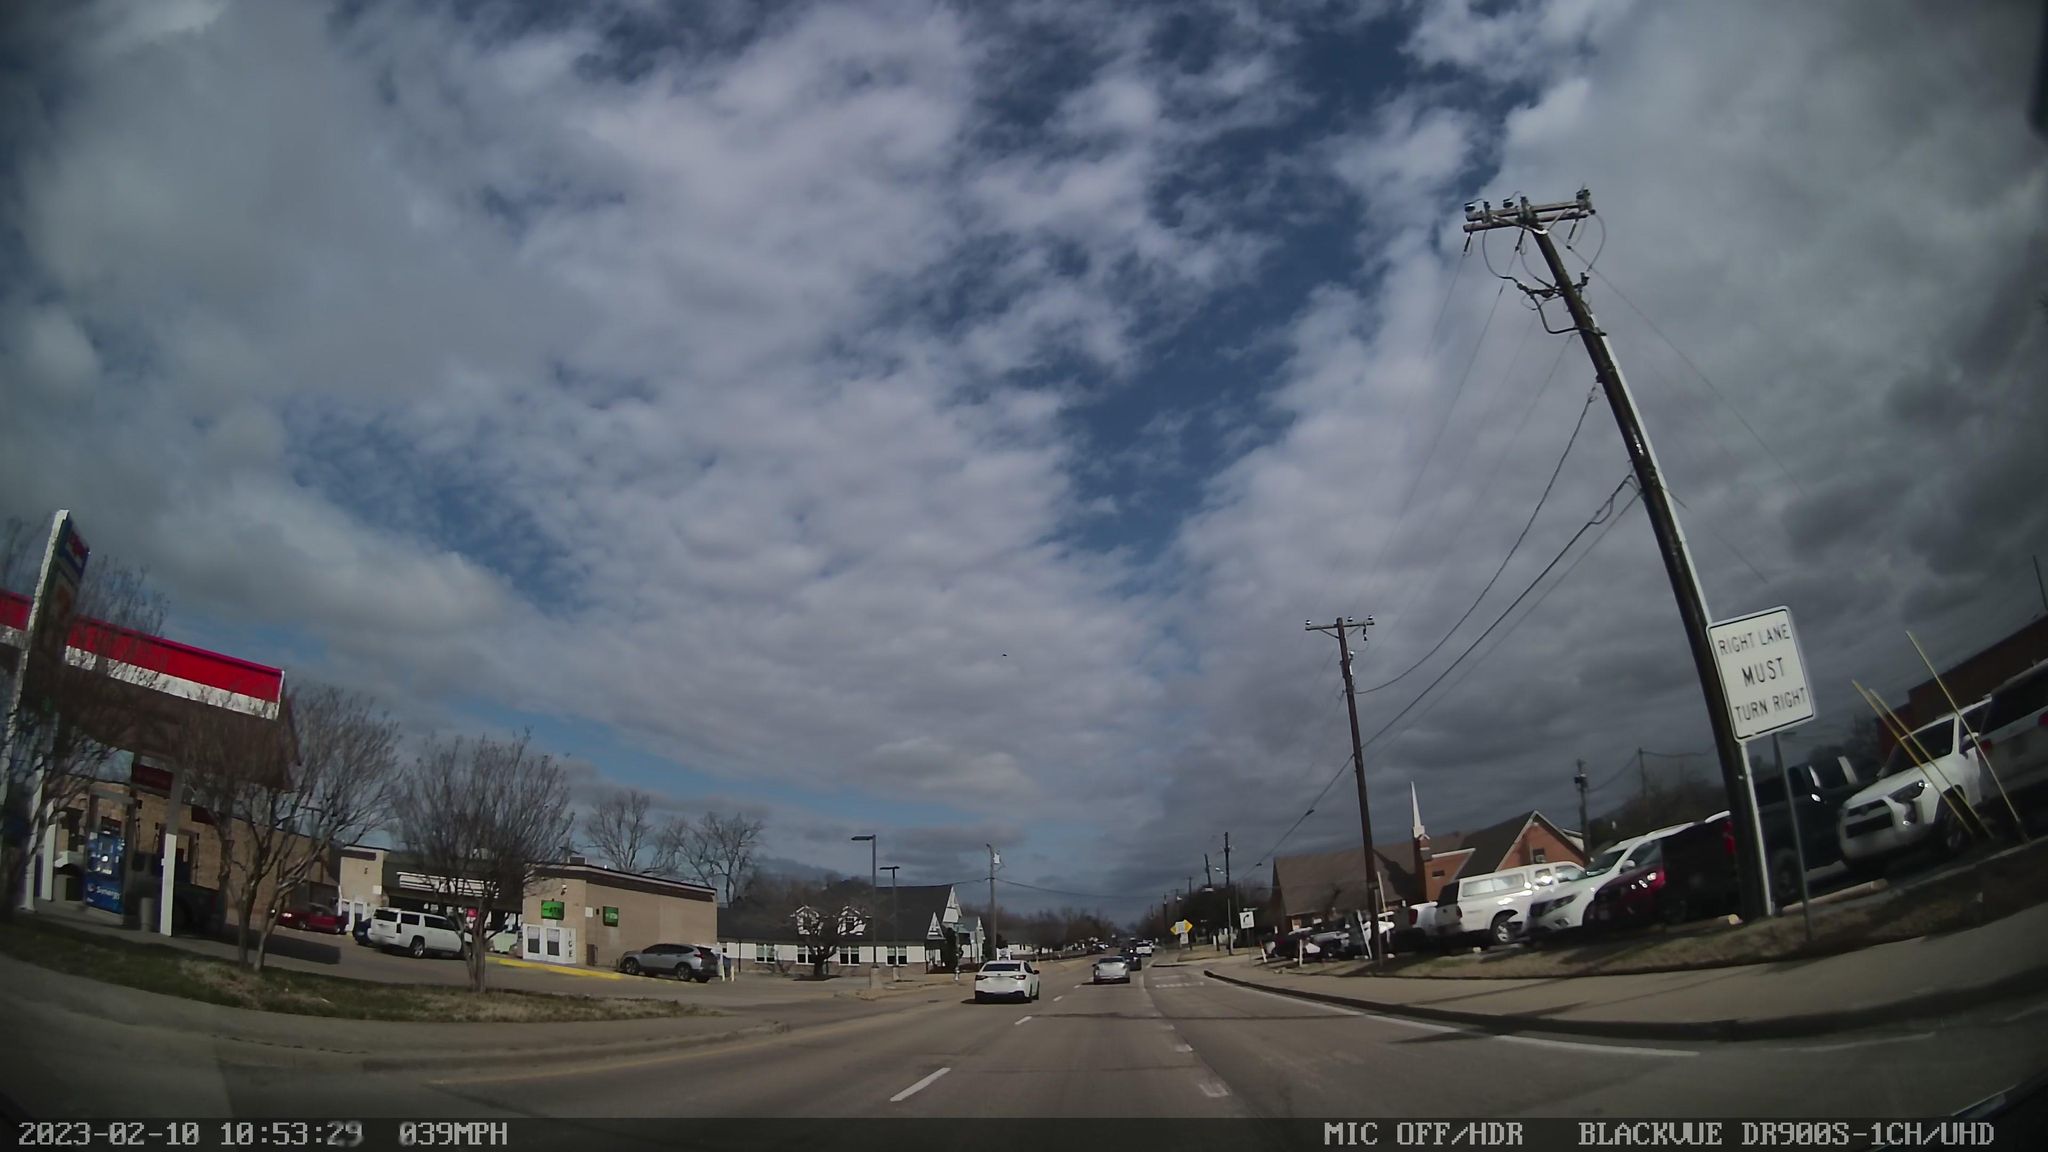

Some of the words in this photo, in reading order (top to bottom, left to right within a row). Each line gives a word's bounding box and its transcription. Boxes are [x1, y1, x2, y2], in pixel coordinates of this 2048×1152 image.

[1718, 632, 1755, 656] RIGHT
[1759, 623, 1790, 646] LANE
[1741, 657, 1785, 688] MUST
[1734, 700, 1768, 723] TURN
[1772, 687, 1806, 711] RIGHT
